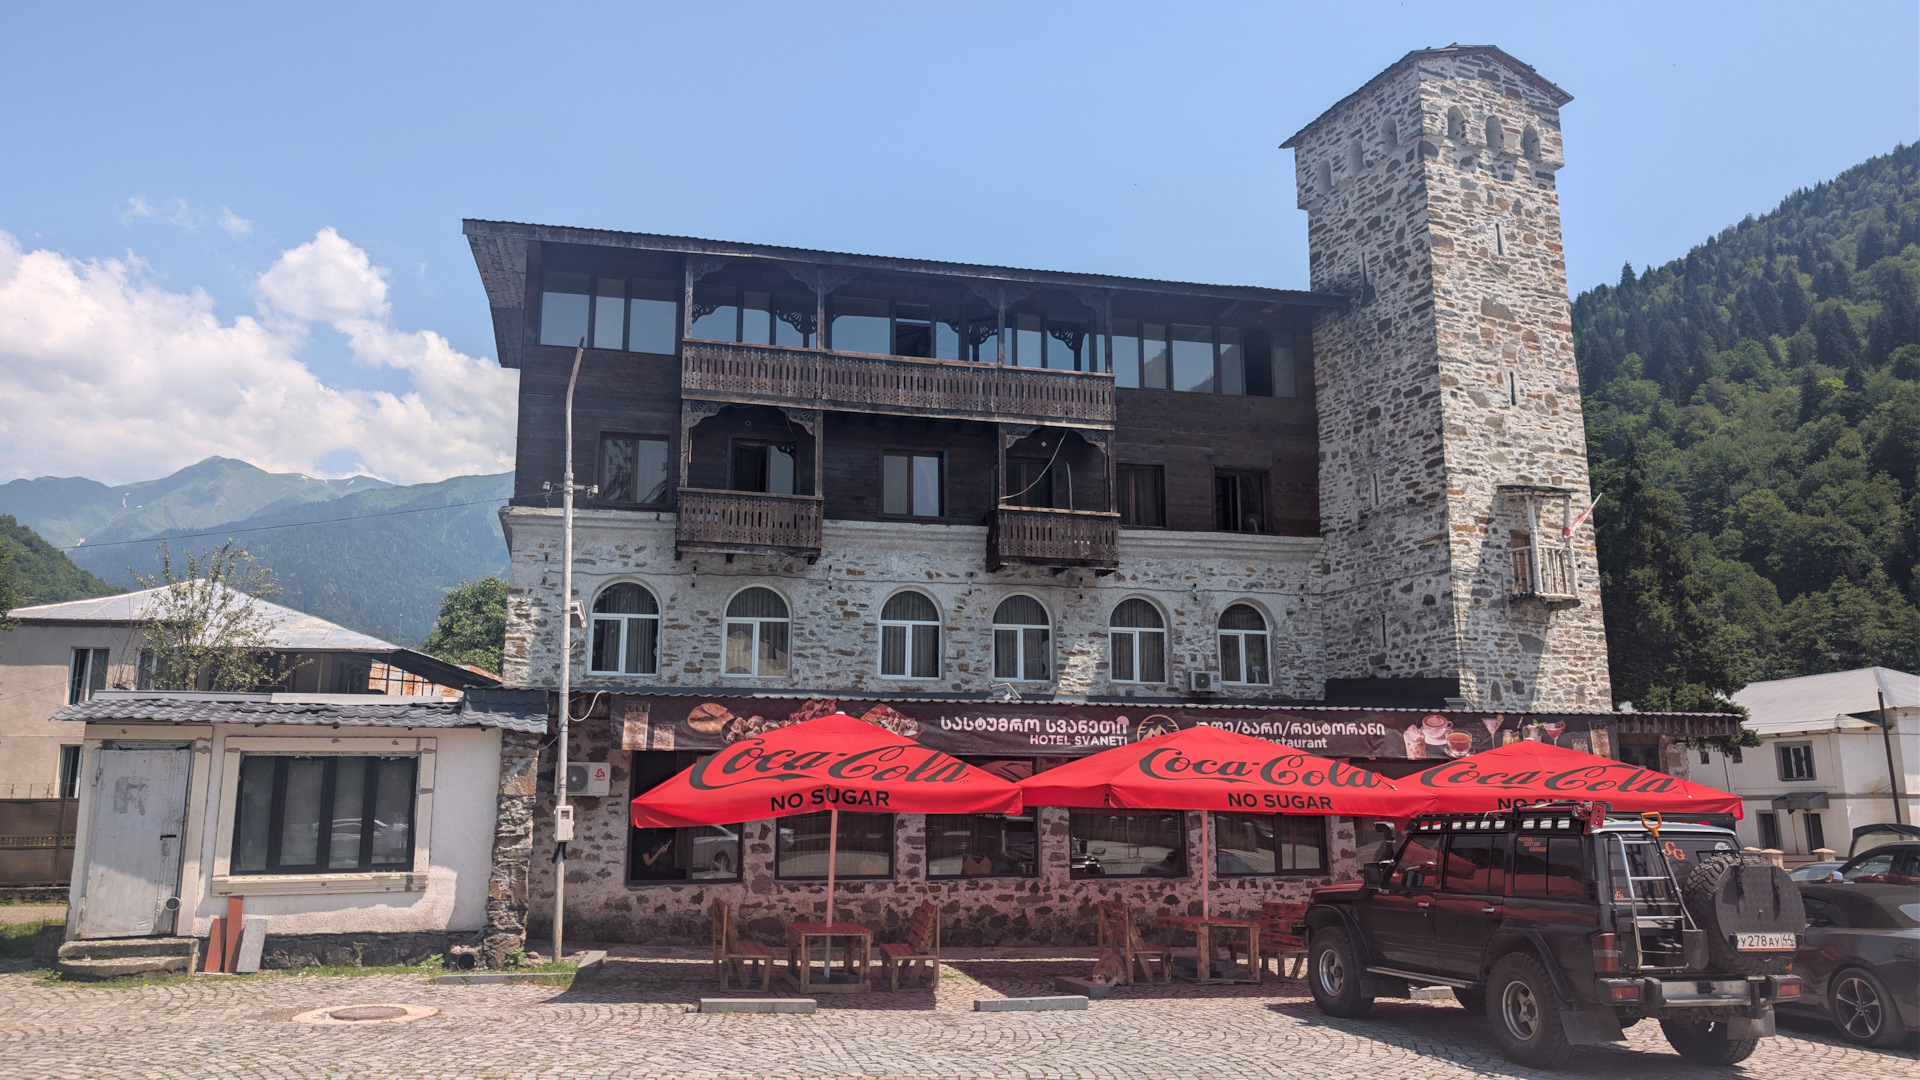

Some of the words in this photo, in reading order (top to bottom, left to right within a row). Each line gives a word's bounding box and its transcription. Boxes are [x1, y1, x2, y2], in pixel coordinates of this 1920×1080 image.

[1030, 735, 1071, 745] HOTEL
[1075, 736, 1128, 746] SVANETI
[689, 738, 971, 790] Coca-Cola
[1139, 748, 1381, 788] Coca-Cola
[1420, 761, 1679, 794] Coca-Cola
[771, 794, 803, 812] NO
[811, 788, 890, 807] SUGAR
[1227, 793, 1257, 808] NO
[1264, 794, 1333, 810] SUGAR
